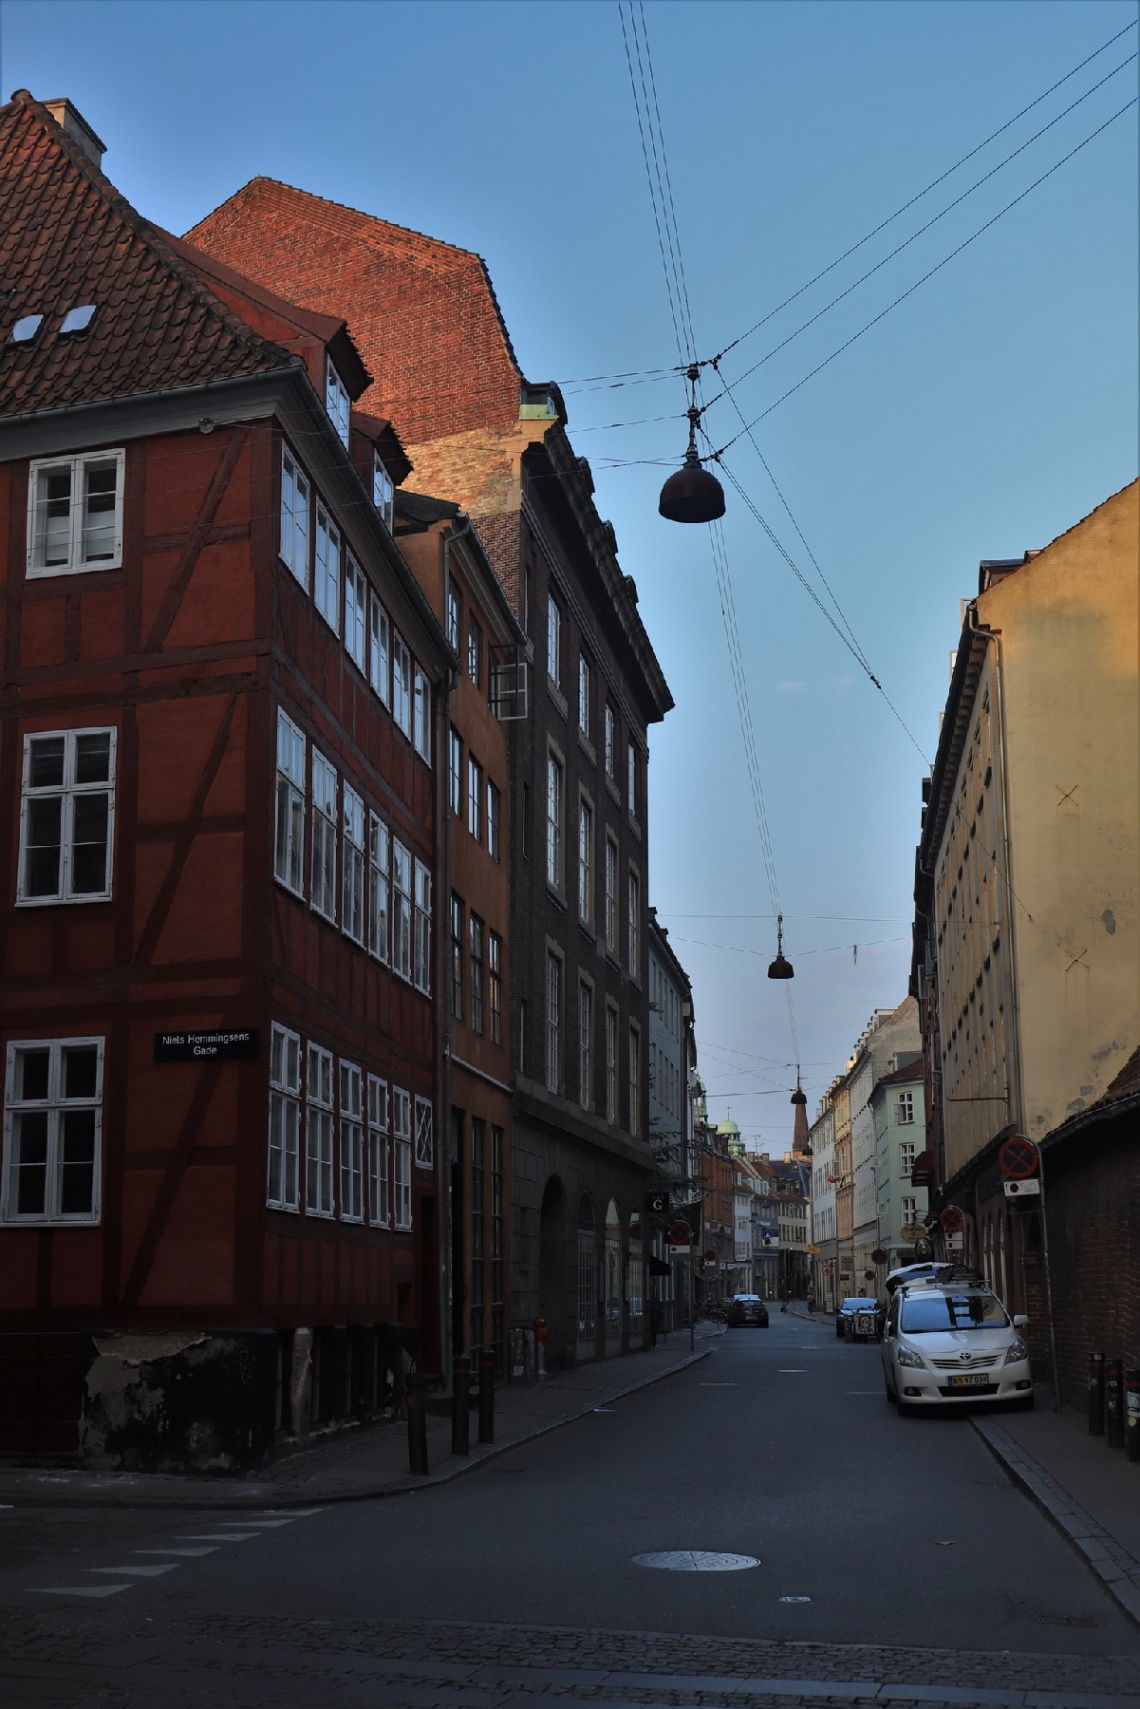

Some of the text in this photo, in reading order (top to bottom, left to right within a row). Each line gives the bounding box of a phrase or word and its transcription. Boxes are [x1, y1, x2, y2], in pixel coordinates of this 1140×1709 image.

[162, 1033, 250, 1045] Niels Hemmingsens
[193, 1046, 218, 1055] Gade
[652, 1199, 663, 1211] G
